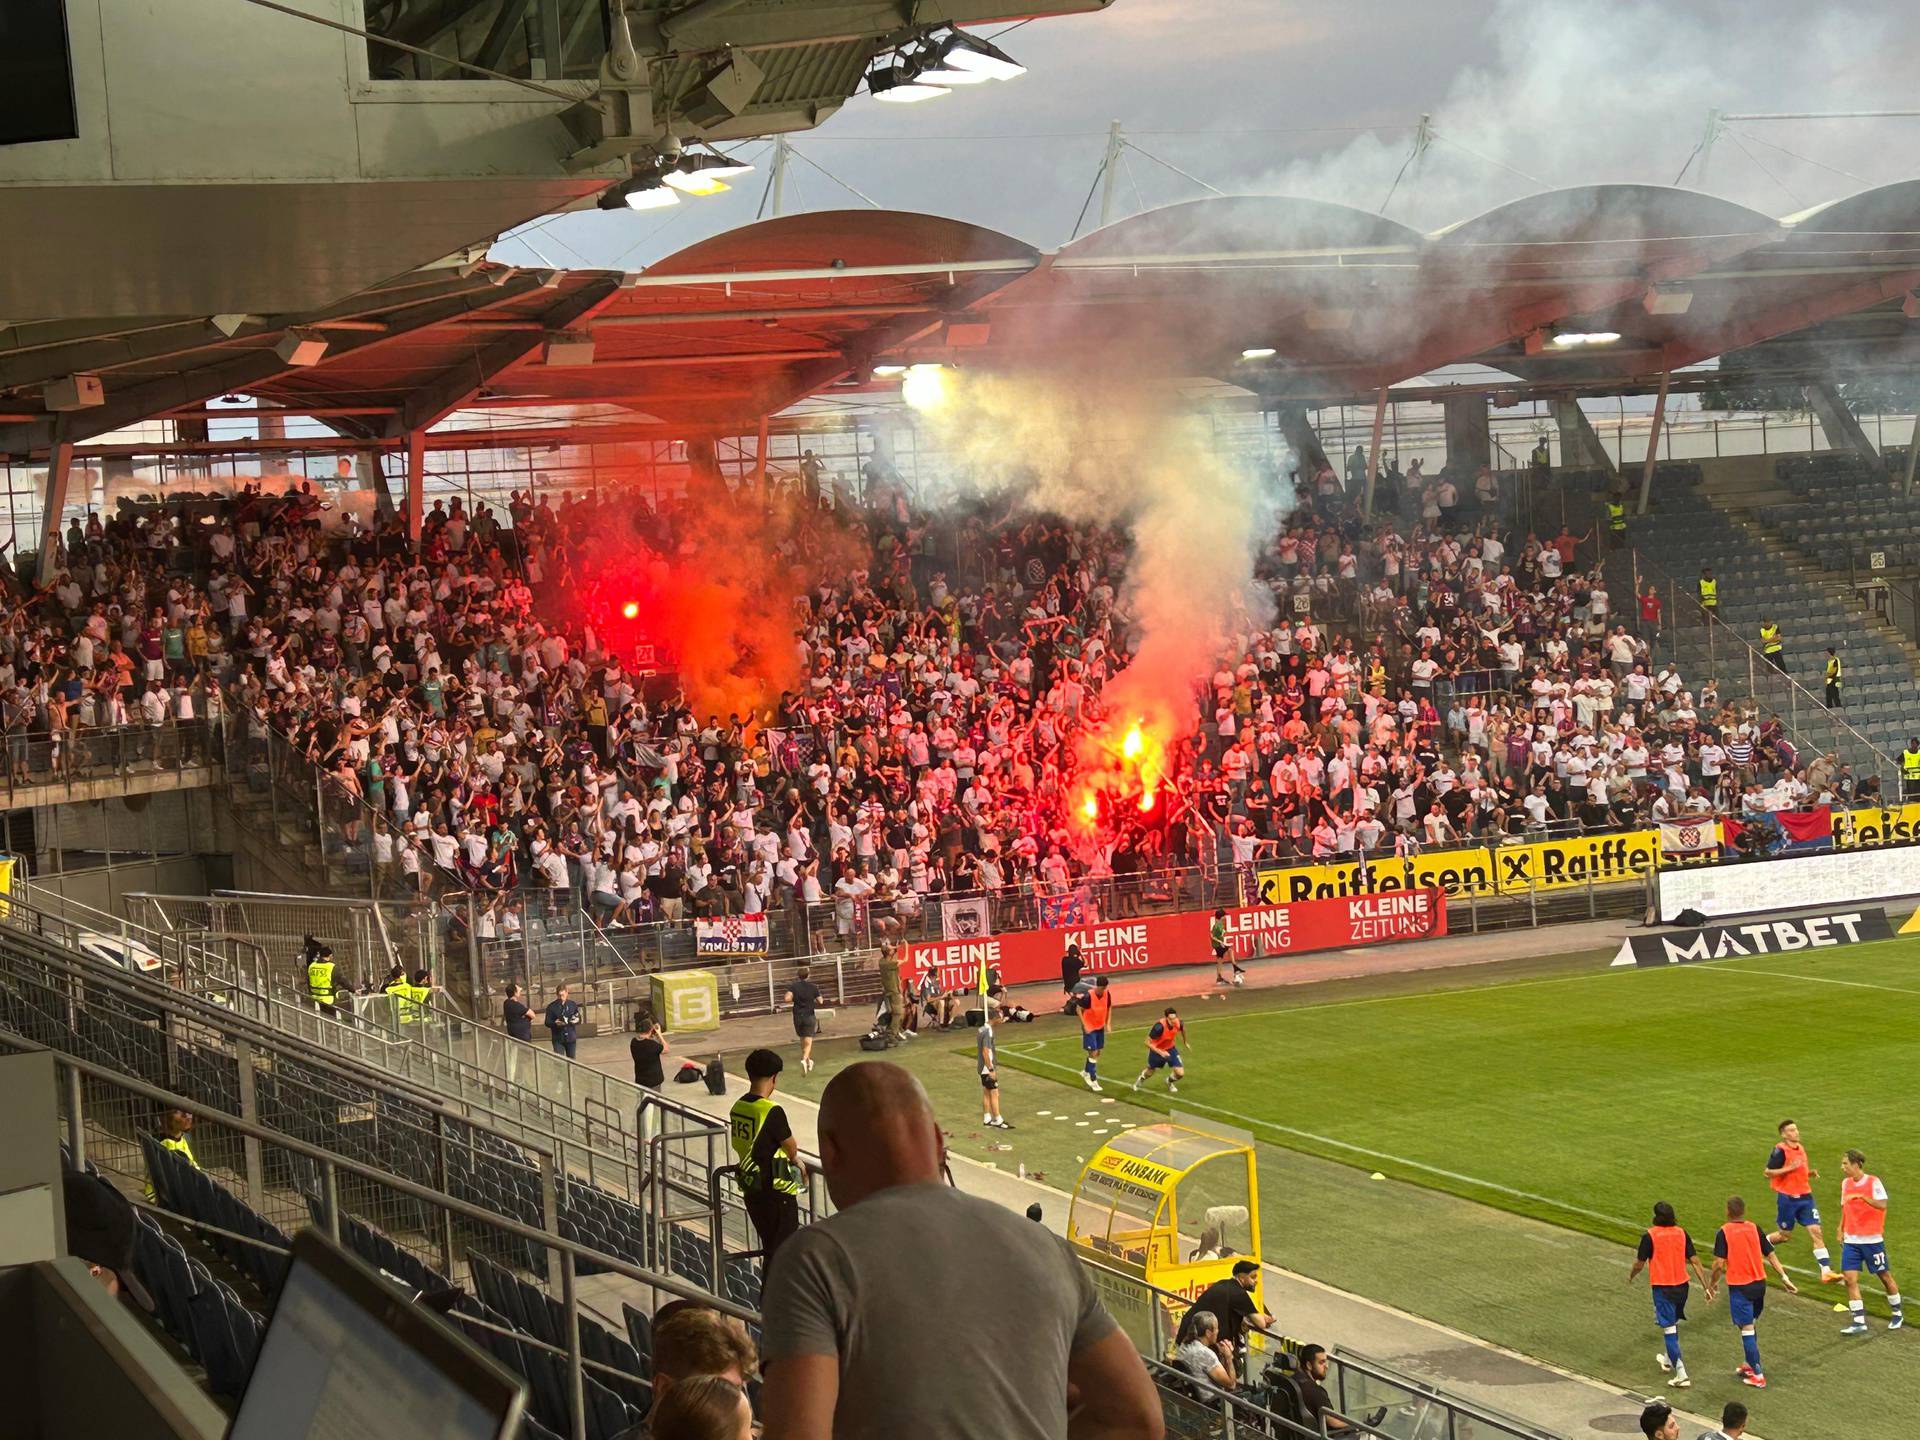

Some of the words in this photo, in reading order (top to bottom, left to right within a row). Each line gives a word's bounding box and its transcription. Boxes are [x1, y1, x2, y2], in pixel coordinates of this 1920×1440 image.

[1290, 861, 1486, 905] Raiffeisen
[1350, 894, 1428, 919] KLEINE
[1065, 925, 1147, 951] KLEINE
[1350, 914, 1430, 940] ZEITUNG
[1662, 913, 1862, 963] MATBET
[915, 941, 1001, 968] KLEINE
[1212, 929, 1291, 956] EITUNG
[1078, 945, 1148, 970] EITUNG
[1121, 1160, 1170, 1185] FANBANK
